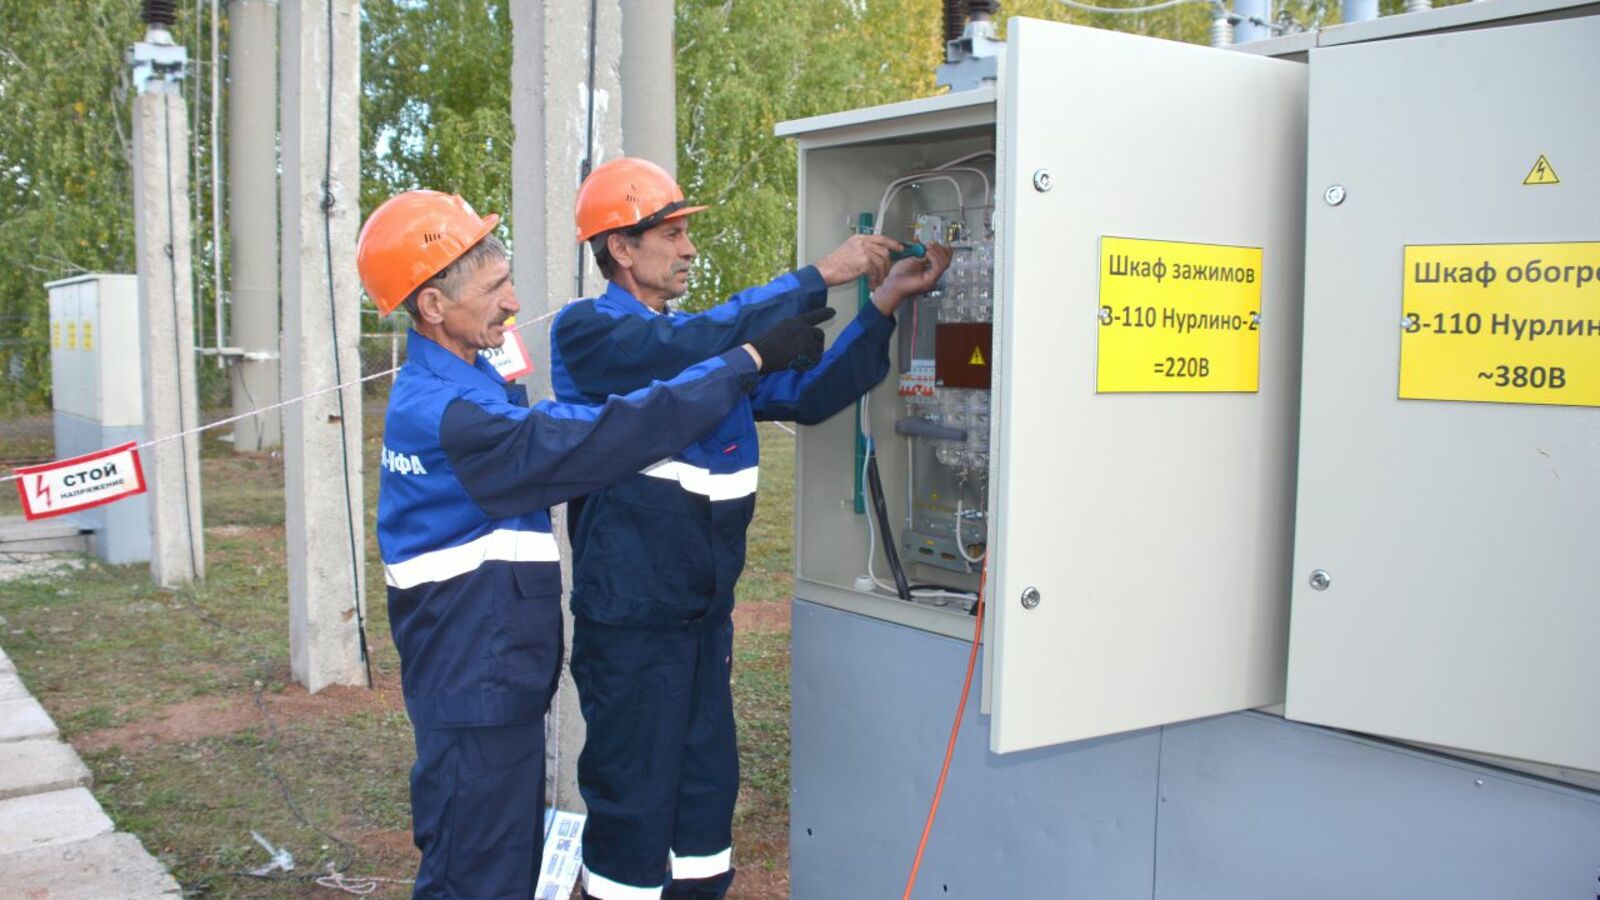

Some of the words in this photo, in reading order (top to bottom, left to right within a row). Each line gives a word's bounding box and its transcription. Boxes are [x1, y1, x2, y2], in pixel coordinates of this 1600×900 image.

[1109, 254, 1167, 283] Шкаф
[1172, 263, 1255, 284] зажимов
[1414, 260, 1497, 288] Шкаф
[1506, 259, 1600, 288] обогр
[1162, 307, 1259, 334] Нурлино-2
[1154, 357, 1210, 377] =220В
[1478, 365, 1566, 389] ~380В
[63, 462, 117, 487] СТОЙ
[60, 478, 125, 500] НАПРЯЖЕНИЕ
